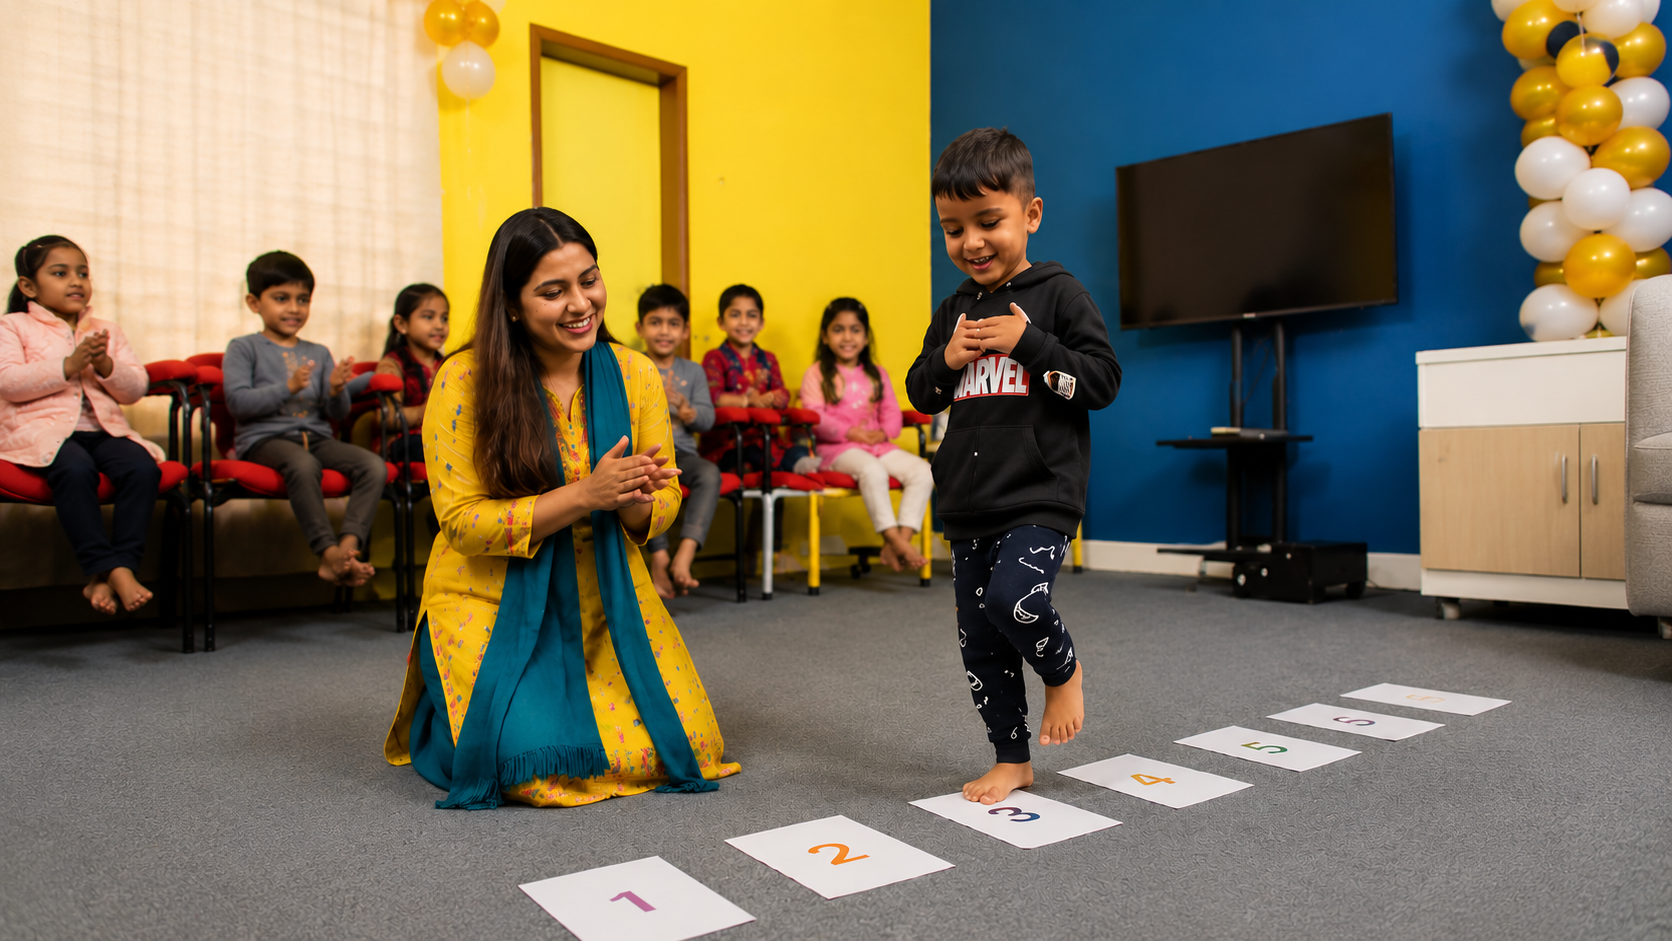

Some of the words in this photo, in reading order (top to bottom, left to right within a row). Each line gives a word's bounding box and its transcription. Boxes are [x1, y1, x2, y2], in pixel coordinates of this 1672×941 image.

[1241, 741, 1288, 754] 5
[1131, 773, 1176, 786] 4
[988, 807, 1040, 822] 3
[808, 843, 870, 866] 2
[609, 890, 656, 913] 1
